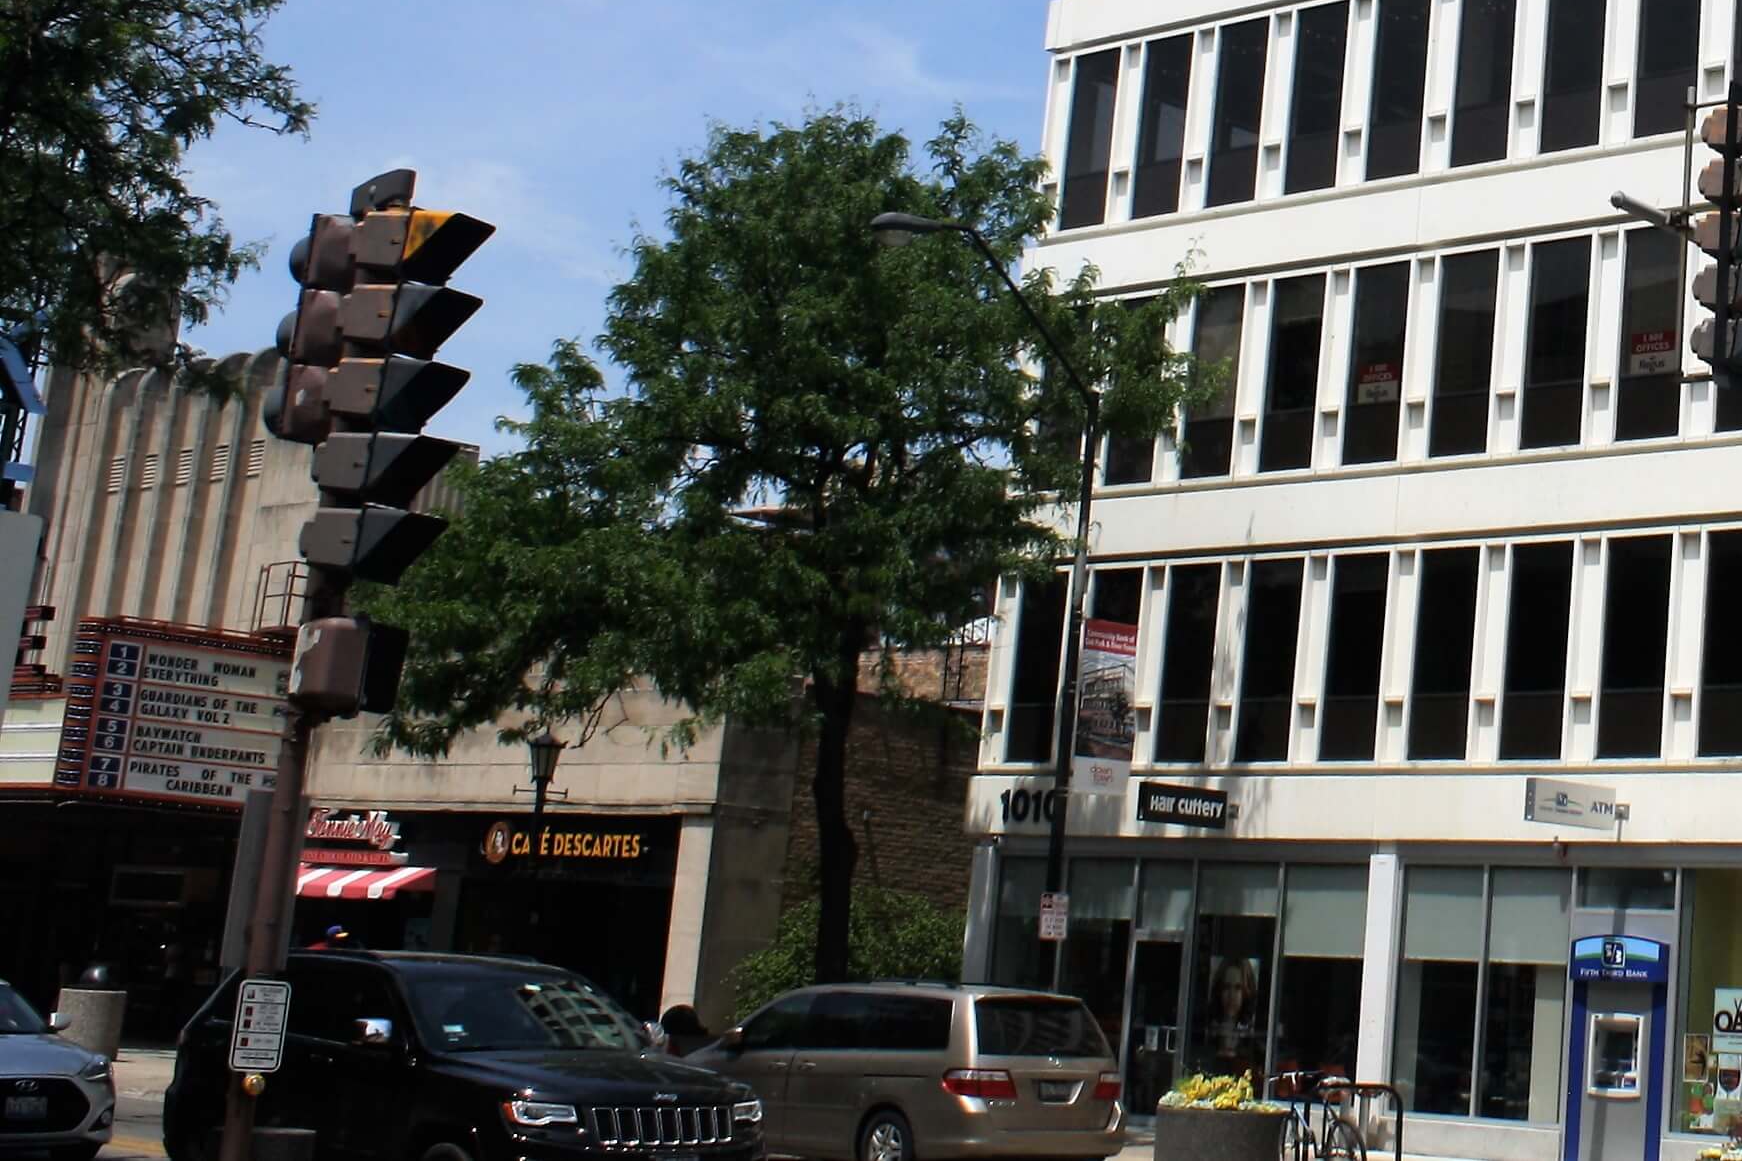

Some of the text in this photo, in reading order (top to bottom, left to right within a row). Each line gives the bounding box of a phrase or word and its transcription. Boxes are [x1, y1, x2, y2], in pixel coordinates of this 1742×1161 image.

[119, 646, 128, 658] 1
[117, 661, 127, 674] 2
[149, 654, 256, 678] WONDER WOMAN
[144, 668, 219, 687] EVERYTHING
[112, 684, 123, 696] 3
[109, 699, 120, 711] 4
[140, 689, 207, 707] GUARDIANS
[213, 699, 228, 710] OF
[236, 700, 257, 714] THE
[141, 703, 230, 725] GALAXY VOL 2
[107, 720, 117, 732] 5
[136, 726, 202, 743] BAYWATCH
[104, 737, 114, 749] 6
[132, 740, 266, 764] CAPTAIN UNDERPANTS
[101, 758, 111, 770] 7
[97, 774, 109, 787] 8
[130, 761, 180, 777] PIRATES
[201, 769, 217, 781] OF
[231, 772, 252, 785] THE
[165, 780, 233, 797] CARIBBEAN
[1590, 801, 1613, 815] ATM
[511, 826, 641, 858] CAÉ DESCARTES
